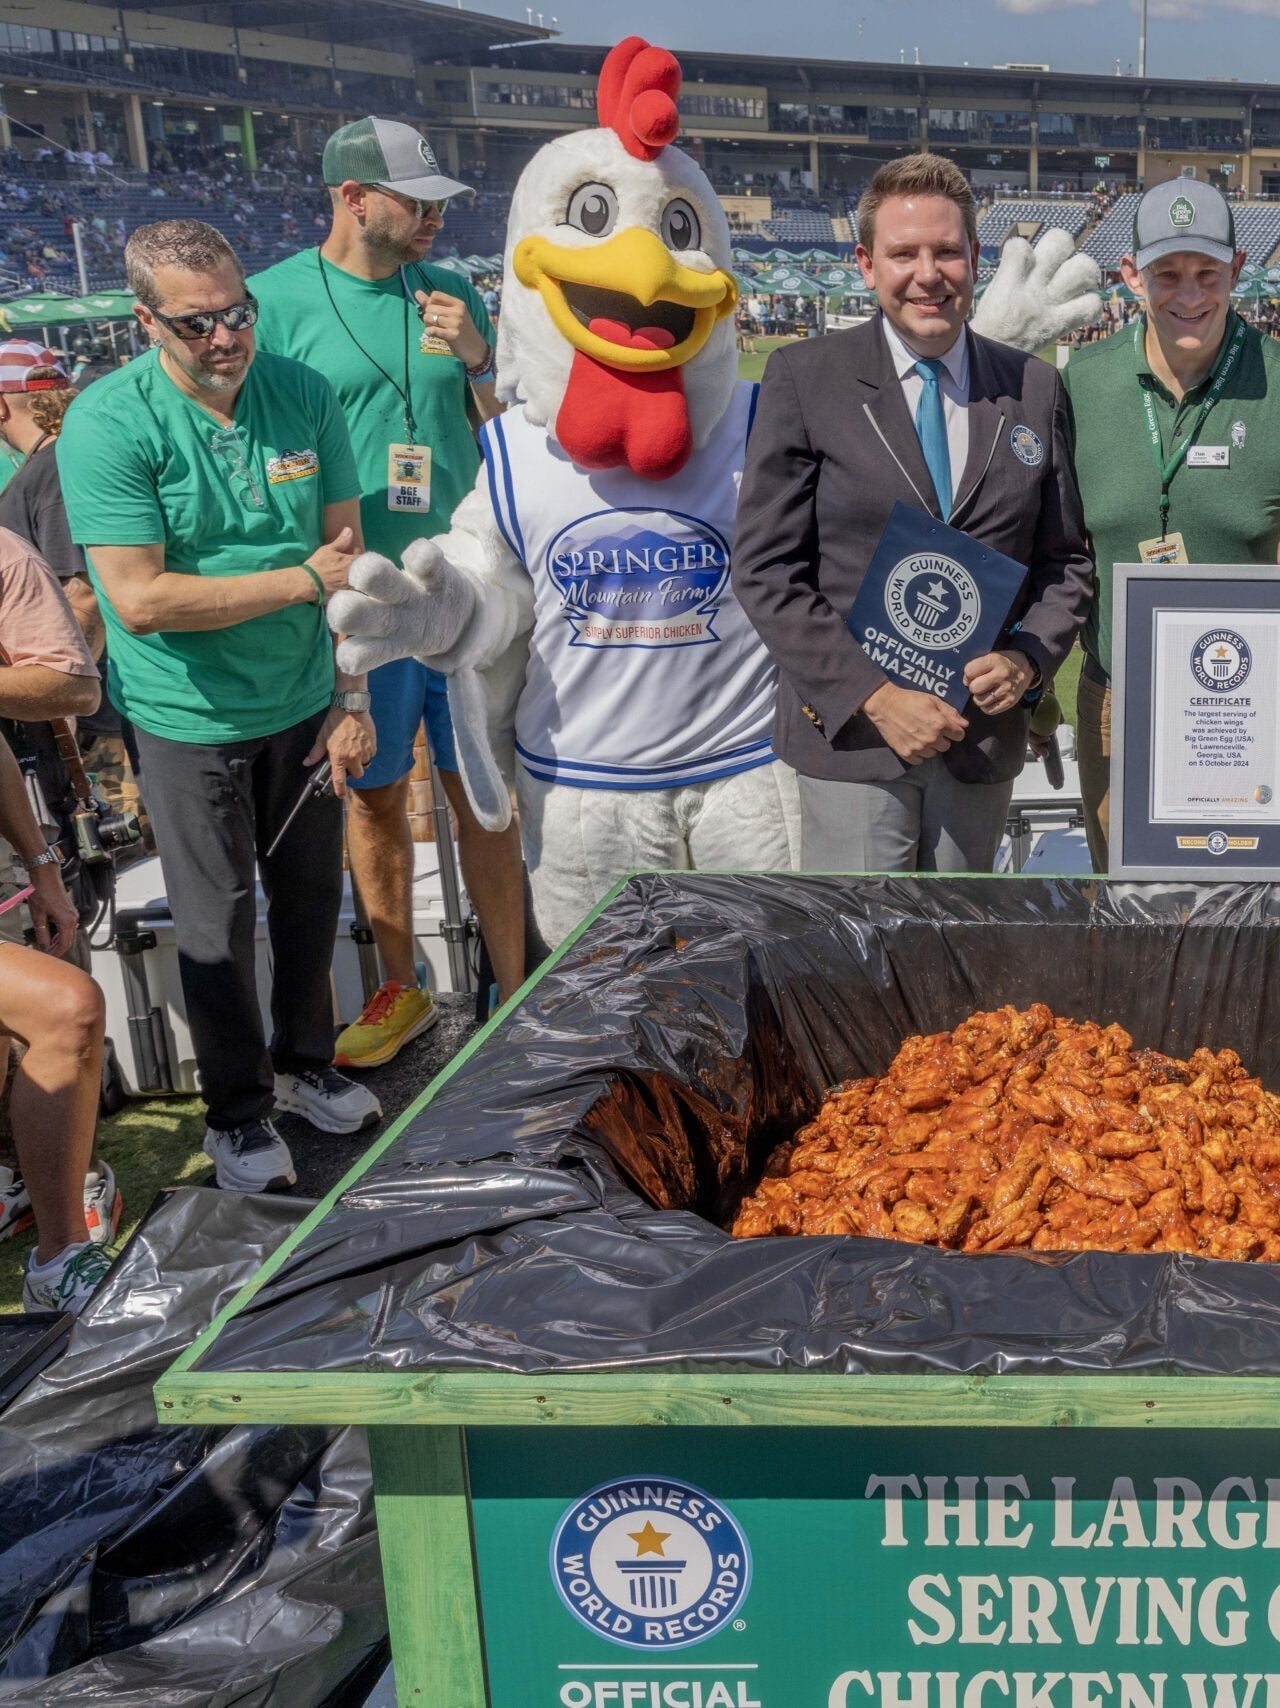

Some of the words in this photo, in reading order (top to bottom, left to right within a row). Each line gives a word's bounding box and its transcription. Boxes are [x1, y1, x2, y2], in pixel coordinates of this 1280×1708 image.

[1221, 356, 1234, 376] Green
[1229, 344, 1240, 355] Big
[1146, 408, 1155, 430] Green
[396, 496, 421, 506] STAFF
[401, 486, 417, 496] BGE
[554, 543, 722, 577] SPRINGER
[560, 577, 653, 611] Mountain
[658, 576, 711, 606] Farms
[910, 559, 974, 600] GUINNESS
[891, 578, 910, 628] WORLD
[912, 613, 972, 644] RECORDS
[616, 626, 660, 640] SUPERIOR
[664, 624, 702, 640] CHICKEN
[1200, 633, 1244, 650] GUINNESS
[862, 642, 950, 698] AMAZING
[864, 627, 956, 681] OFFICIALLY
[1194, 656, 1214, 686] WORLD
[1216, 656, 1248, 690] RECORDS
[576, 1486, 722, 1533] GUINNESS
[864, 1474, 1033, 1548] THE
[562, 1553, 632, 1635] WORLD
[644, 1552, 740, 1641] RECORDS
[908, 1574, 1250, 1646] SERVING
[559, 1680, 762, 1708] OFFICIAL
[828, 1670, 1168, 1708] CHICKEN
